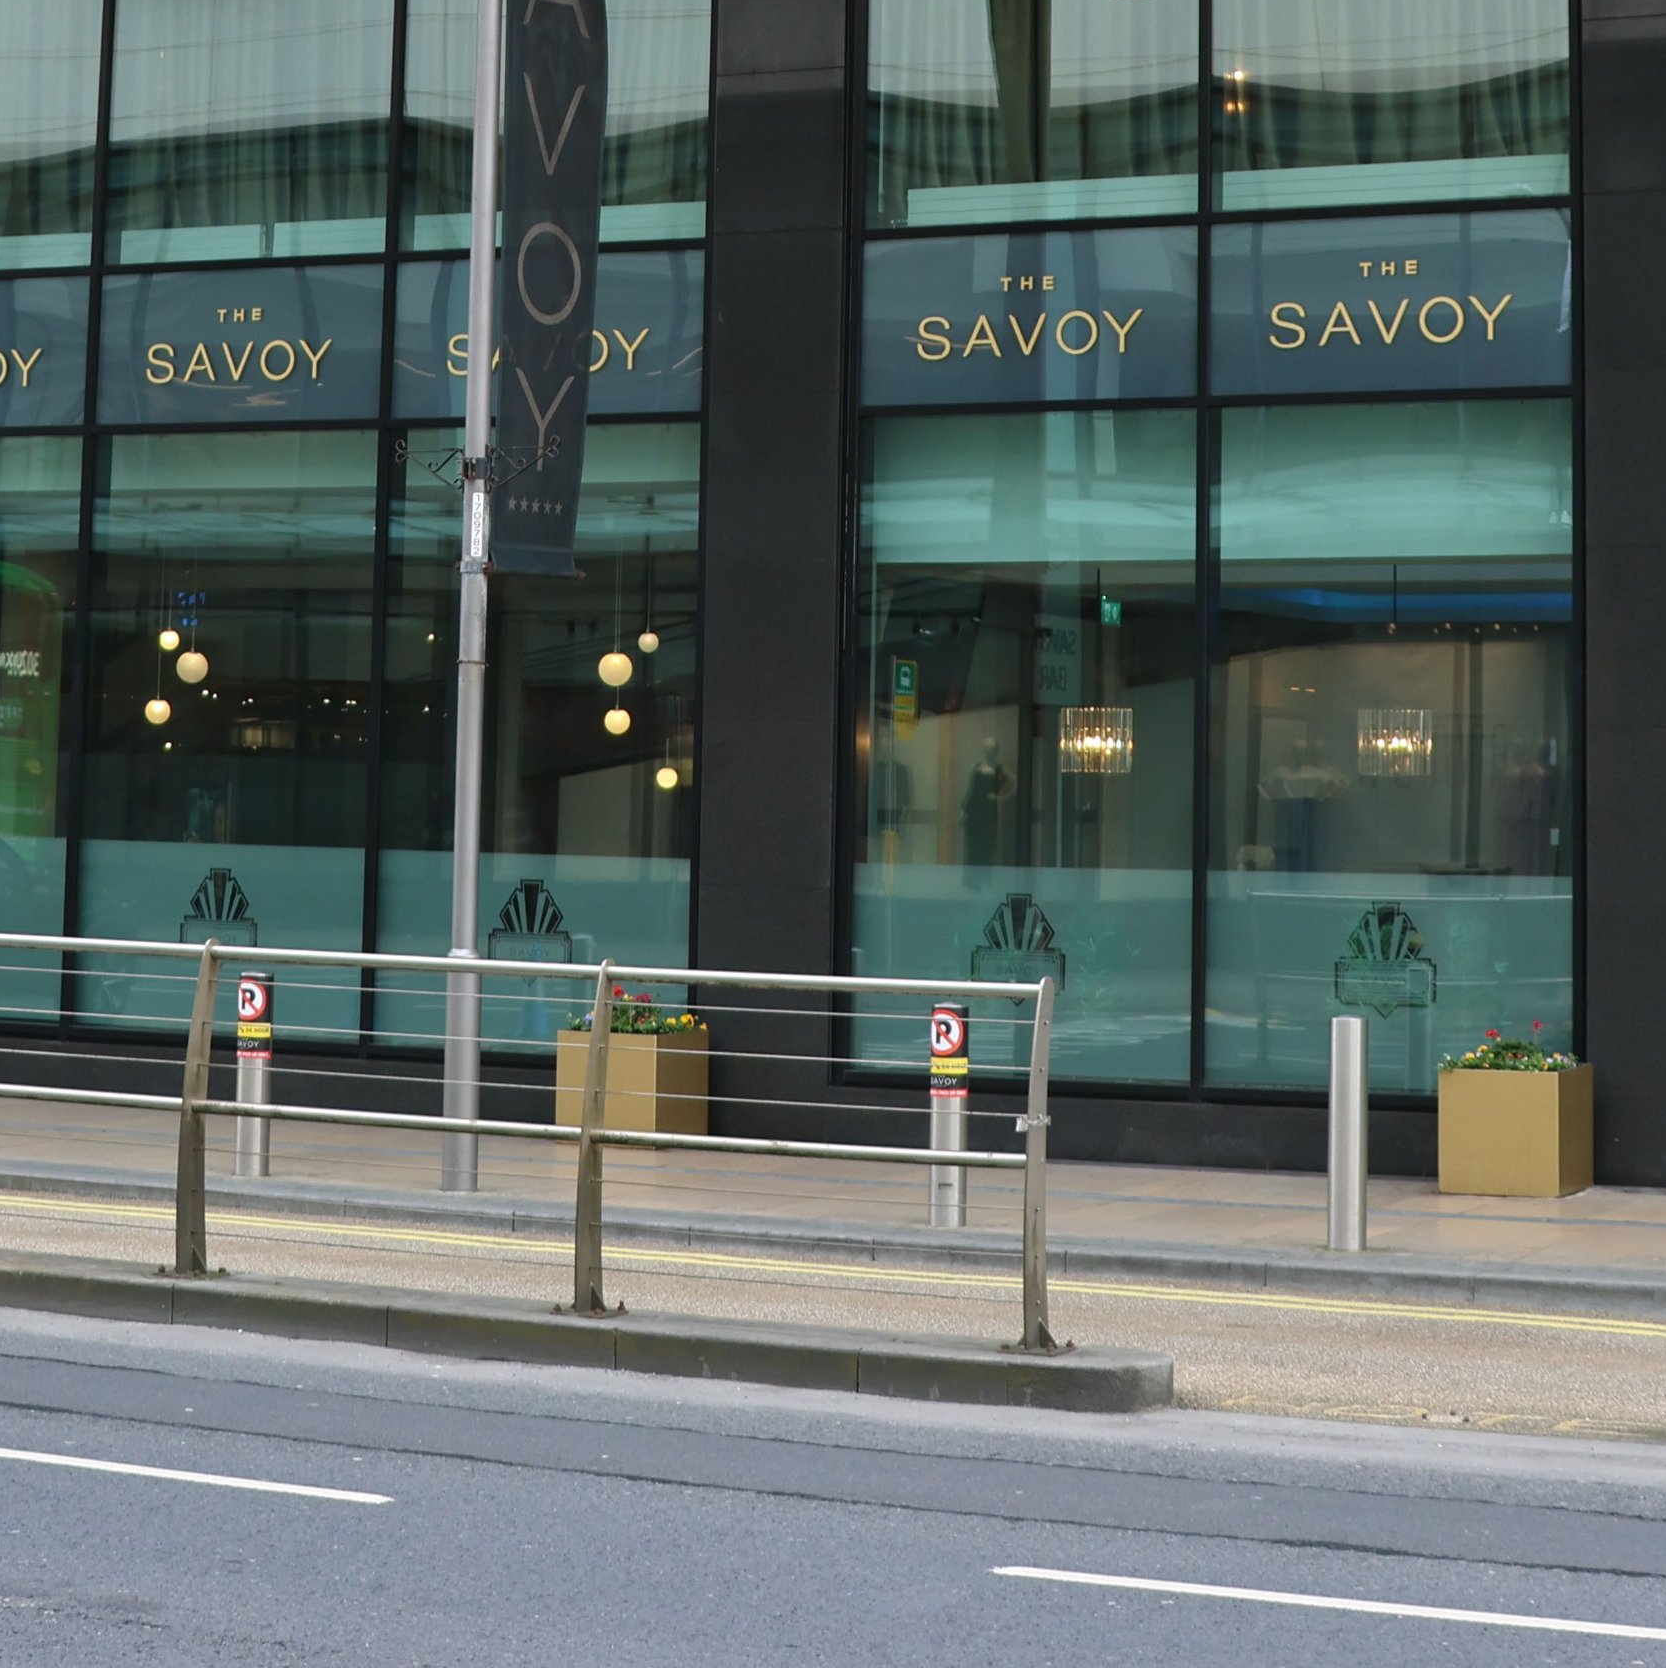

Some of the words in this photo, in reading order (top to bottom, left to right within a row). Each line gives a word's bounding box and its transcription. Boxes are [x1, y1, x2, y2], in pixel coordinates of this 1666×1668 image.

[999, 275, 1056, 292] THE
[1358, 259, 1419, 277] THE
[216, 307, 264, 323] THE
[916, 308, 1144, 362] SAVOY
[1268, 293, 1513, 350] SAVOY
[144, 338, 333, 385] SAVOY
[447, 328, 650, 376] SOY
[473, 494, 482, 555] 1709782
